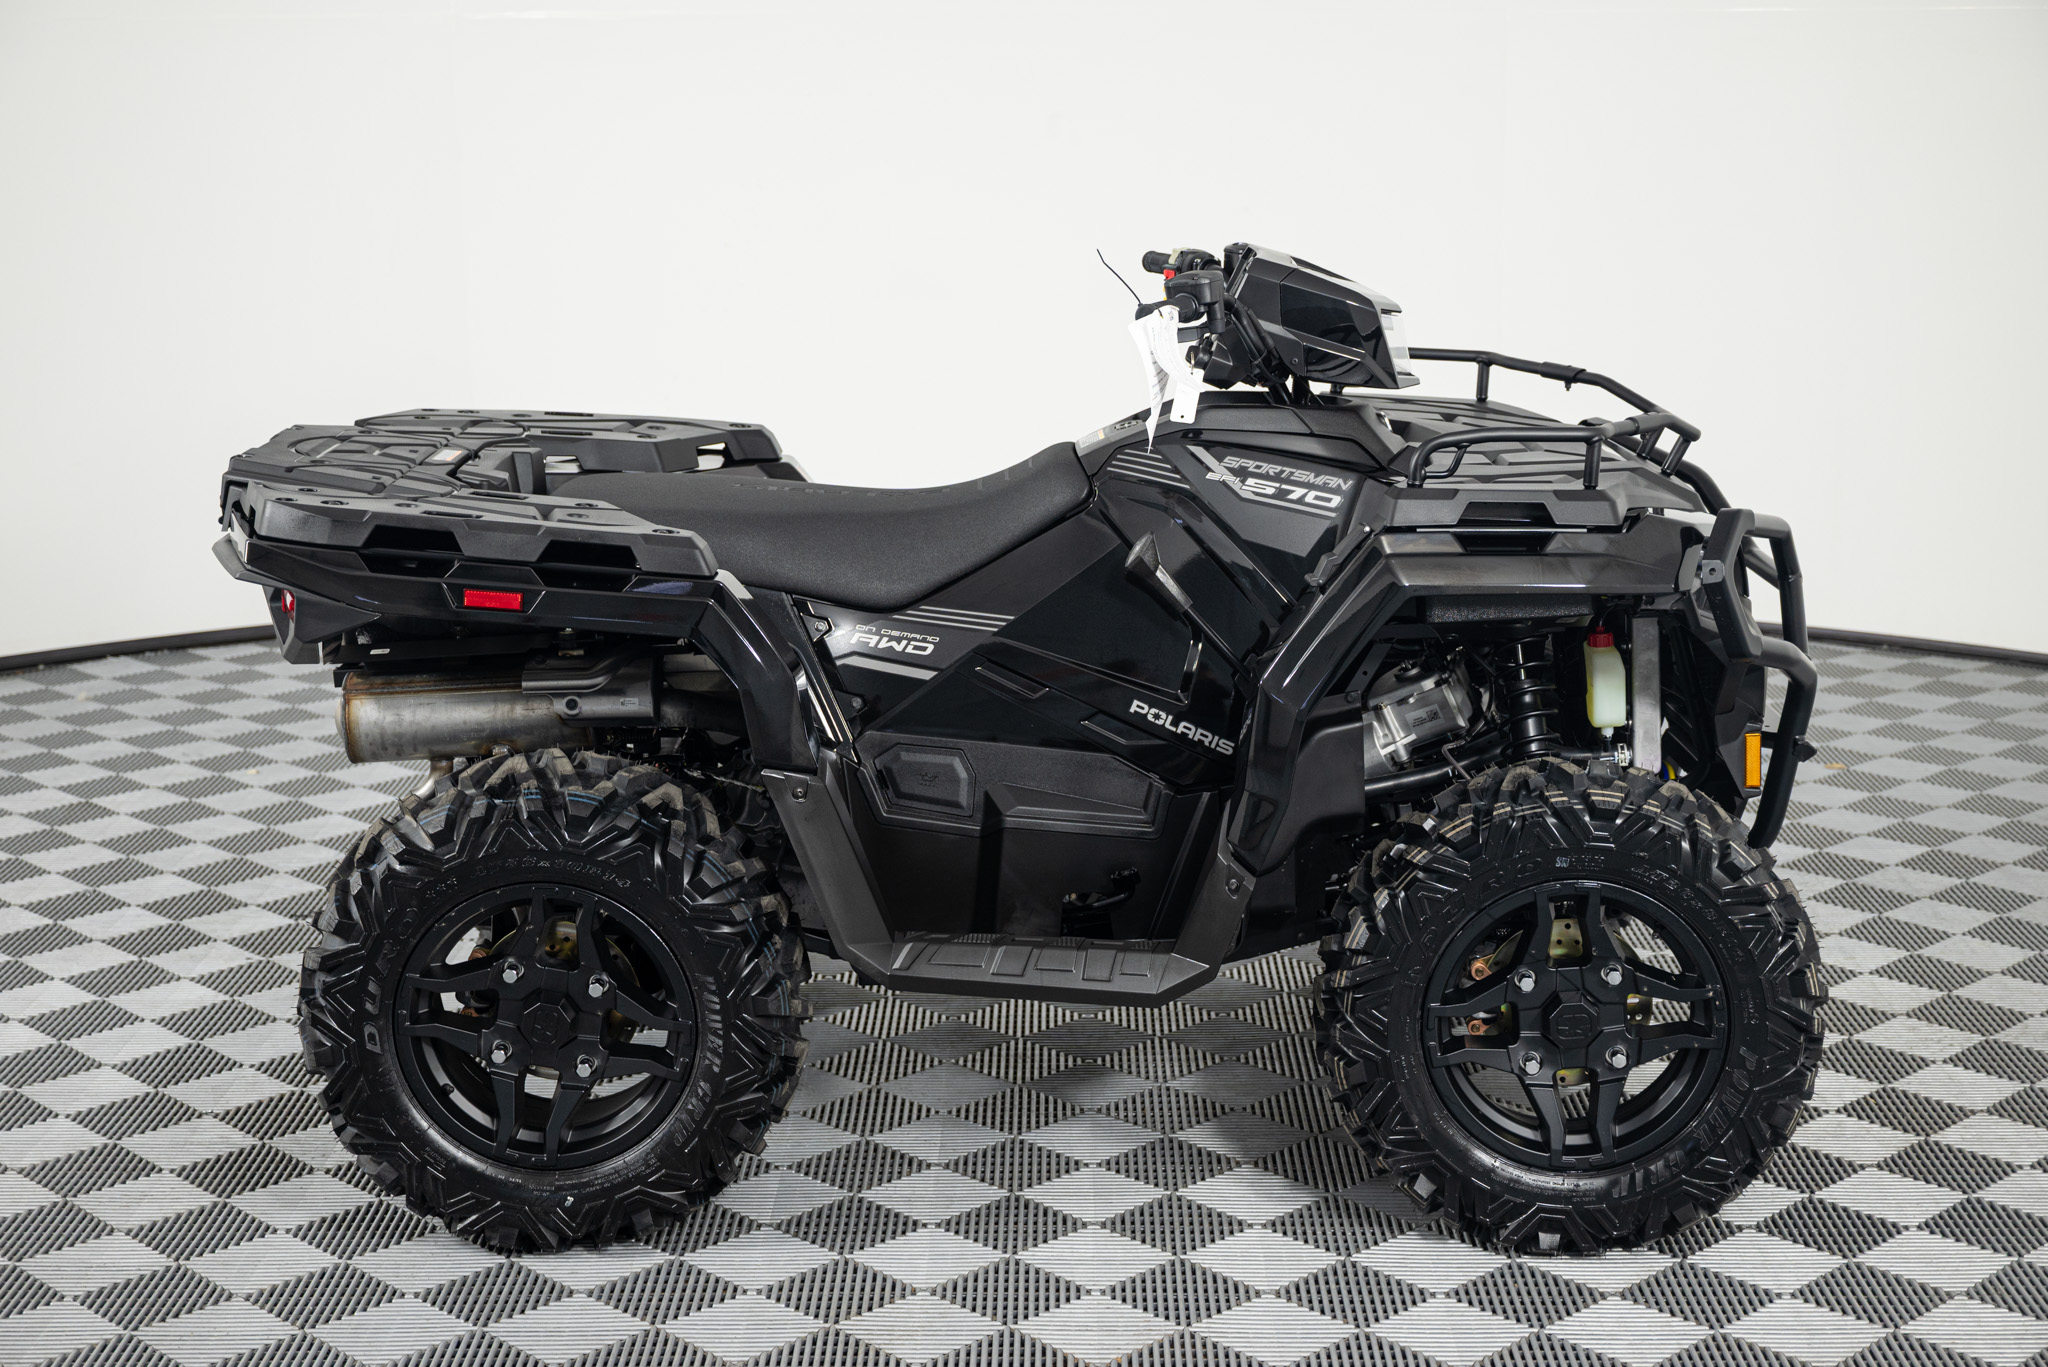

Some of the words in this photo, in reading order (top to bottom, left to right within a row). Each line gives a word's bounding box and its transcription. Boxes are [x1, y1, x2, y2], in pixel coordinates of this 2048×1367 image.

[1205, 471, 1242, 484] EFI
[1240, 477, 1344, 509] 570
[1219, 455, 1354, 491] SPORTSMAN
[849, 632, 935, 655] AWD
[855, 624, 876, 634] ON
[880, 628, 940, 643] DEMAND
[1129, 699, 1236, 756] POLARIS
[694, 972, 725, 1074] POWER
[1692, 1045, 1759, 1152] POWER
